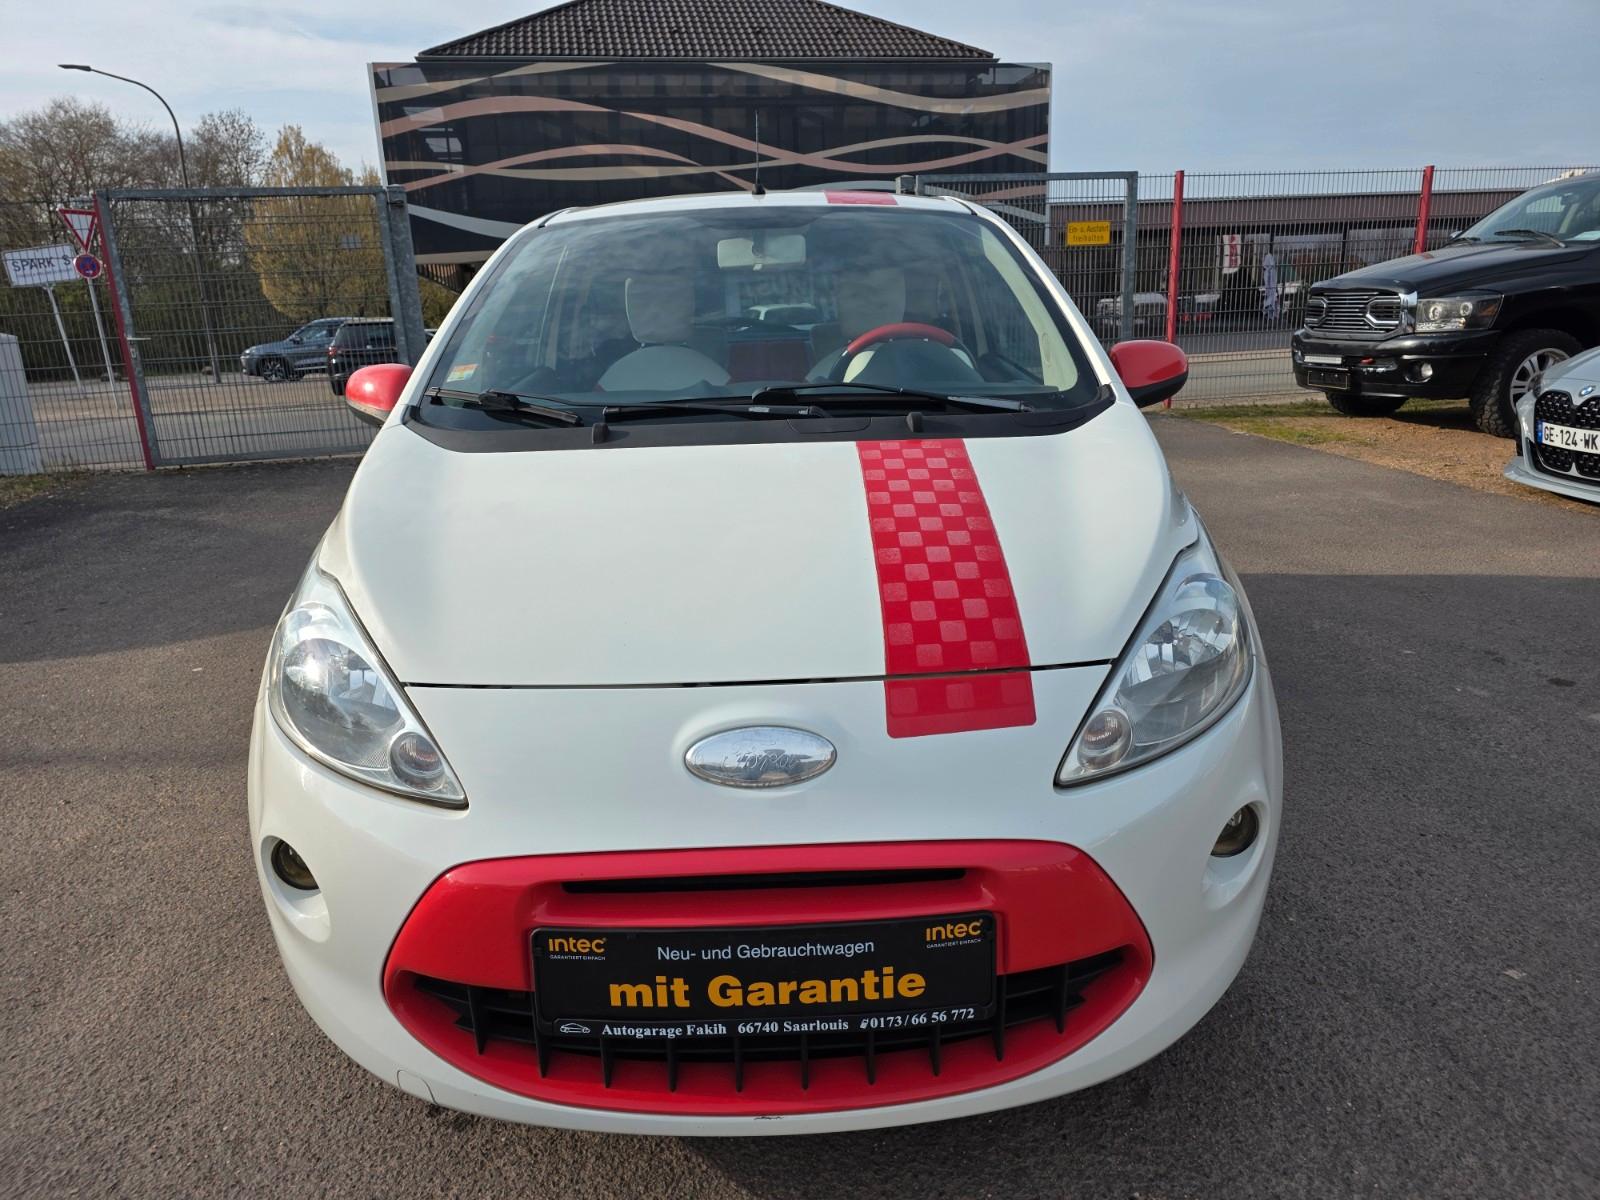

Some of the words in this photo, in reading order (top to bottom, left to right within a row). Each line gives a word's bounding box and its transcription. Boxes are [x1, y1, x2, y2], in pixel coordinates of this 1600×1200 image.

[657, 946, 696, 961] Neu-
[701, 945, 731, 960] und
[737, 941, 875, 959] Gebrauchtwagen
[609, 975, 690, 1008] mit
[707, 966, 926, 1008] Garantie
[602, 1024, 682, 1039] Autogarage
[687, 1023, 727, 1036] Fakih
[737, 1020, 779, 1034] 66740
[783, 1018, 849, 1032] Saarlouis
[931, 1010, 947, 1024] 56
[951, 1008, 975, 1021] 772
